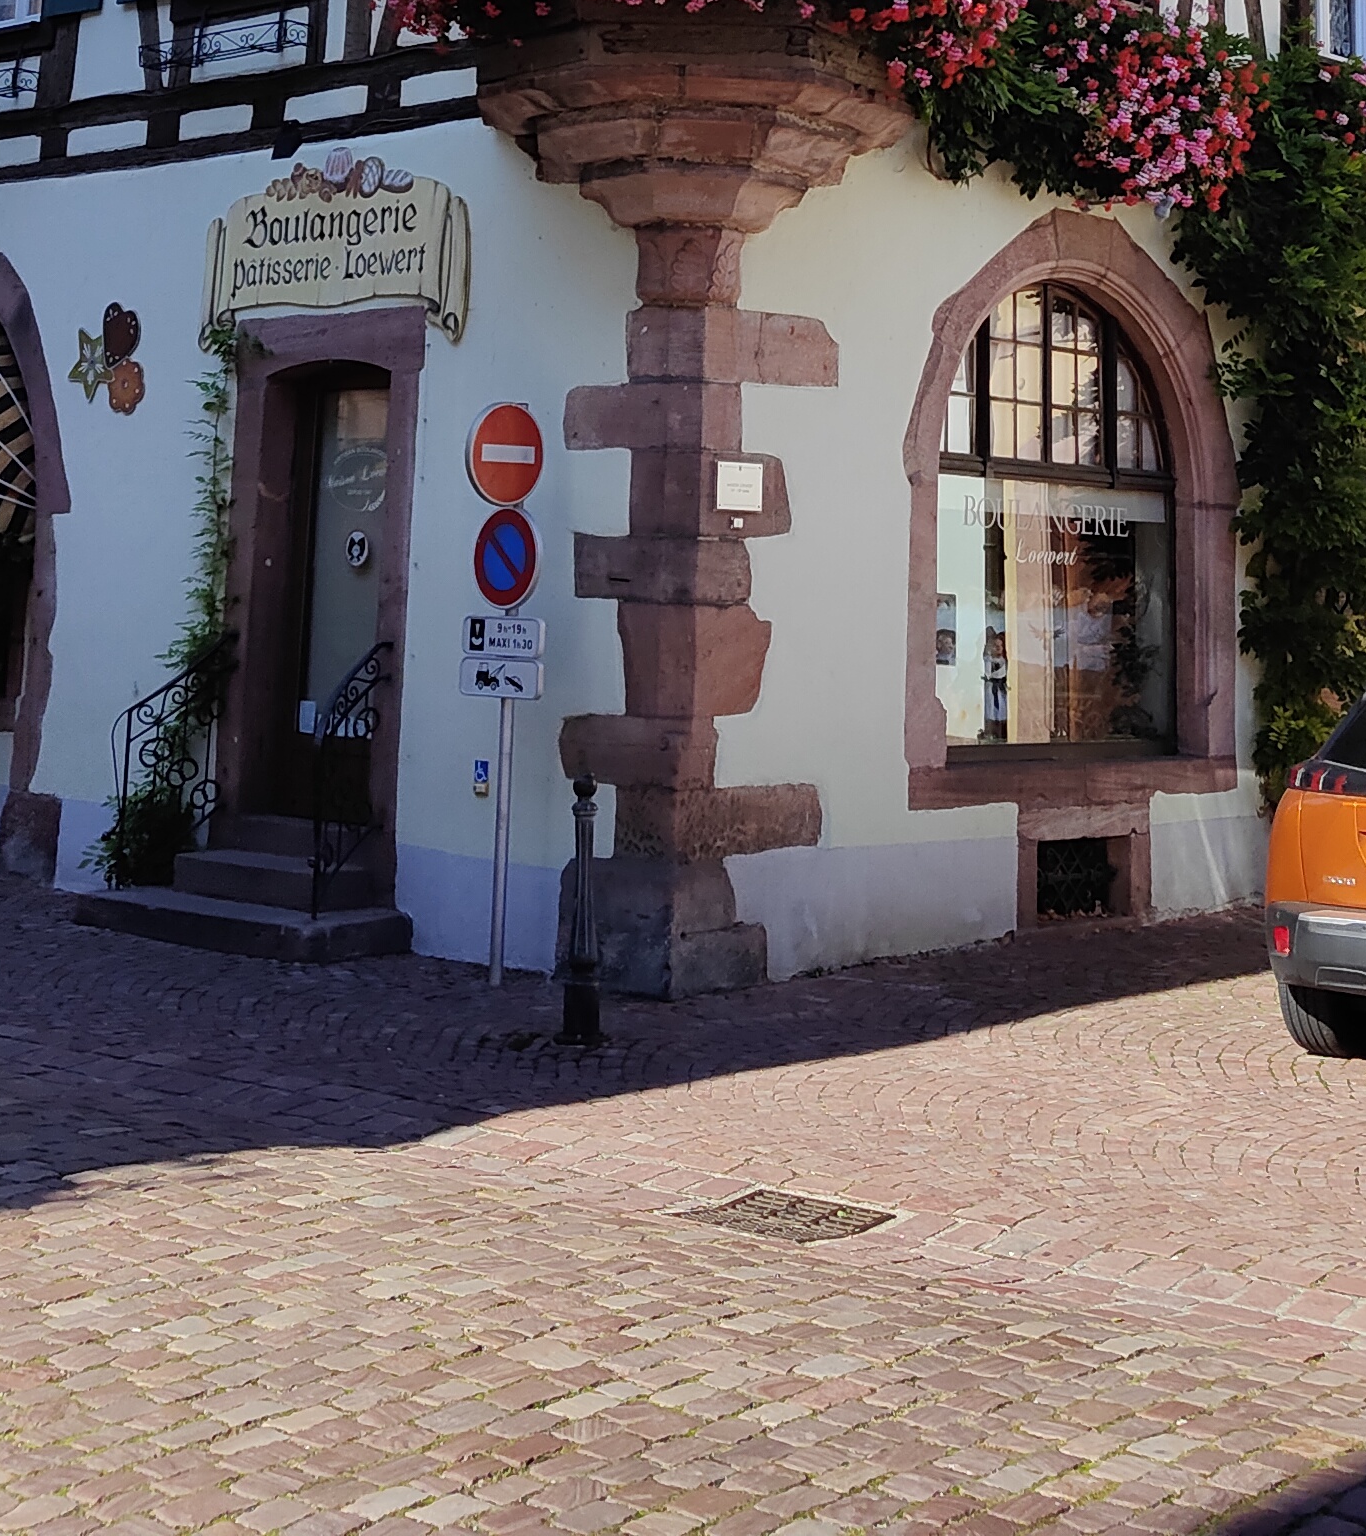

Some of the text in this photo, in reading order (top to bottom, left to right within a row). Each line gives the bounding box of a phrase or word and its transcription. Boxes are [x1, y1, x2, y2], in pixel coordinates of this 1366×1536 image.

[242, 199, 417, 249] Boulangerie
[342, 243, 426, 281] Loewert
[963, 495, 1130, 538] BOULANGERIE
[1015, 539, 1079, 566] Loewert
[488, 637, 533, 650] MAXI 1h30
